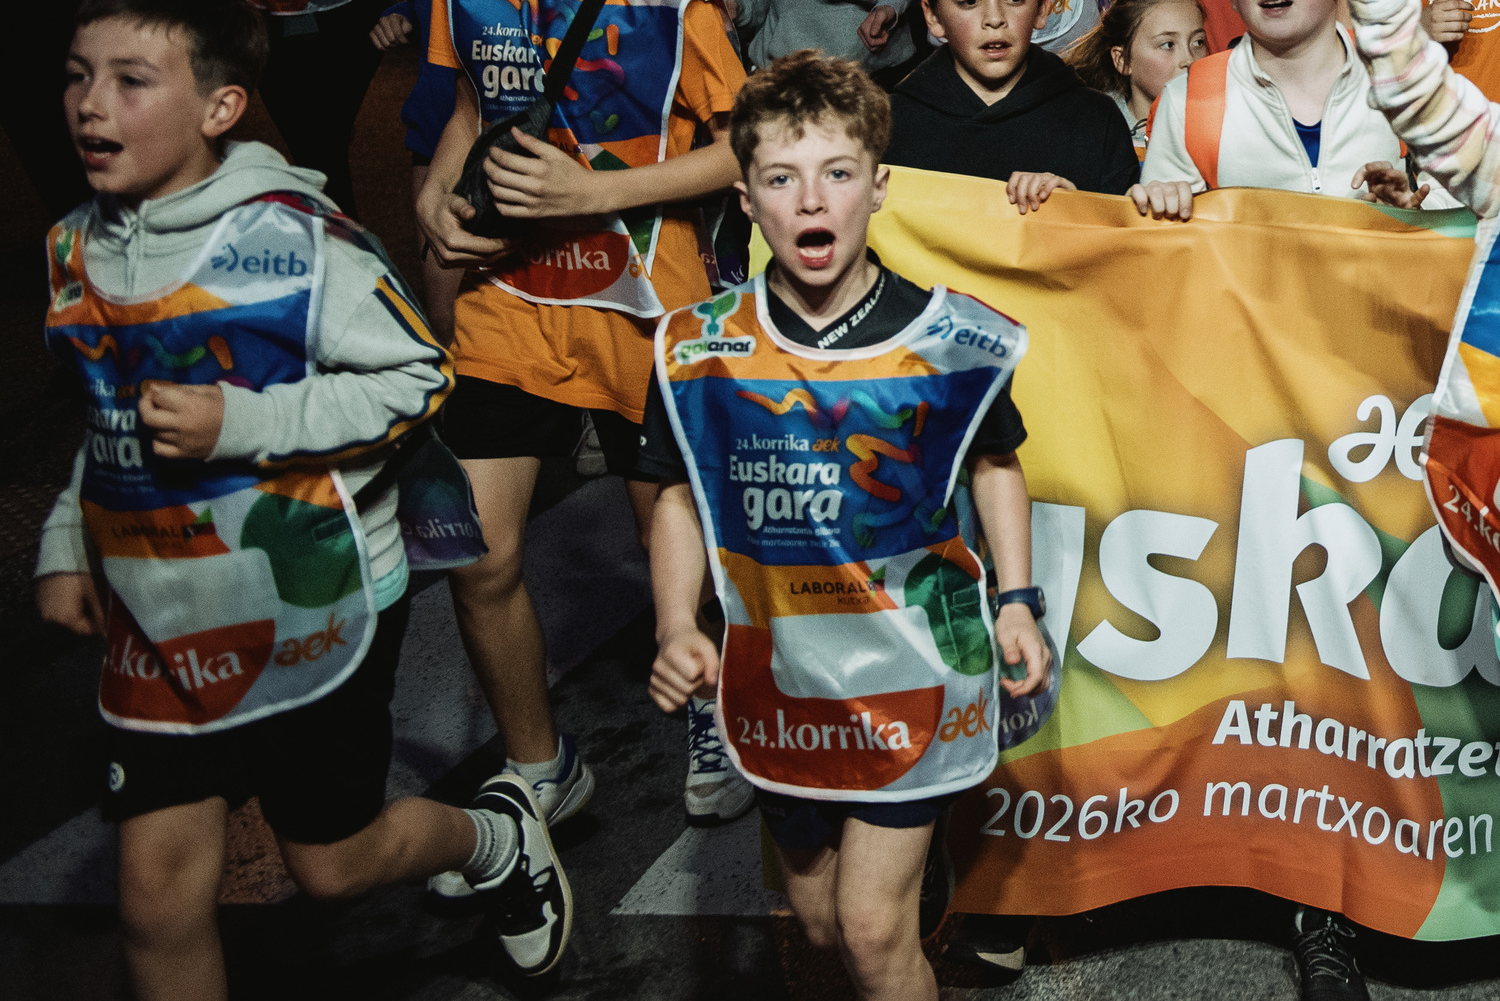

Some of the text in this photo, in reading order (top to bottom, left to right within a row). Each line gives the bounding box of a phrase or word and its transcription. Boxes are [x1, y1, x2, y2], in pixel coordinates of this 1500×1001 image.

[242, 249, 308, 277] eitb
[817, 321, 849, 351] NEW
[955, 323, 1007, 359] eitb
[87, 434, 144, 469] ara
[736, 433, 810, 452] 24.korrika
[1328, 392, 1435, 484] ae
[728, 454, 842, 486] Euskara
[742, 486, 844, 531] gara
[790, 580, 867, 596] LABORAL
[273, 611, 349, 668] aek
[736, 707, 912, 751] 24.korrika
[938, 686, 991, 743] aek
[979, 786, 1180, 842] 2026ko
[1202, 780, 1494, 861] martxoaren
